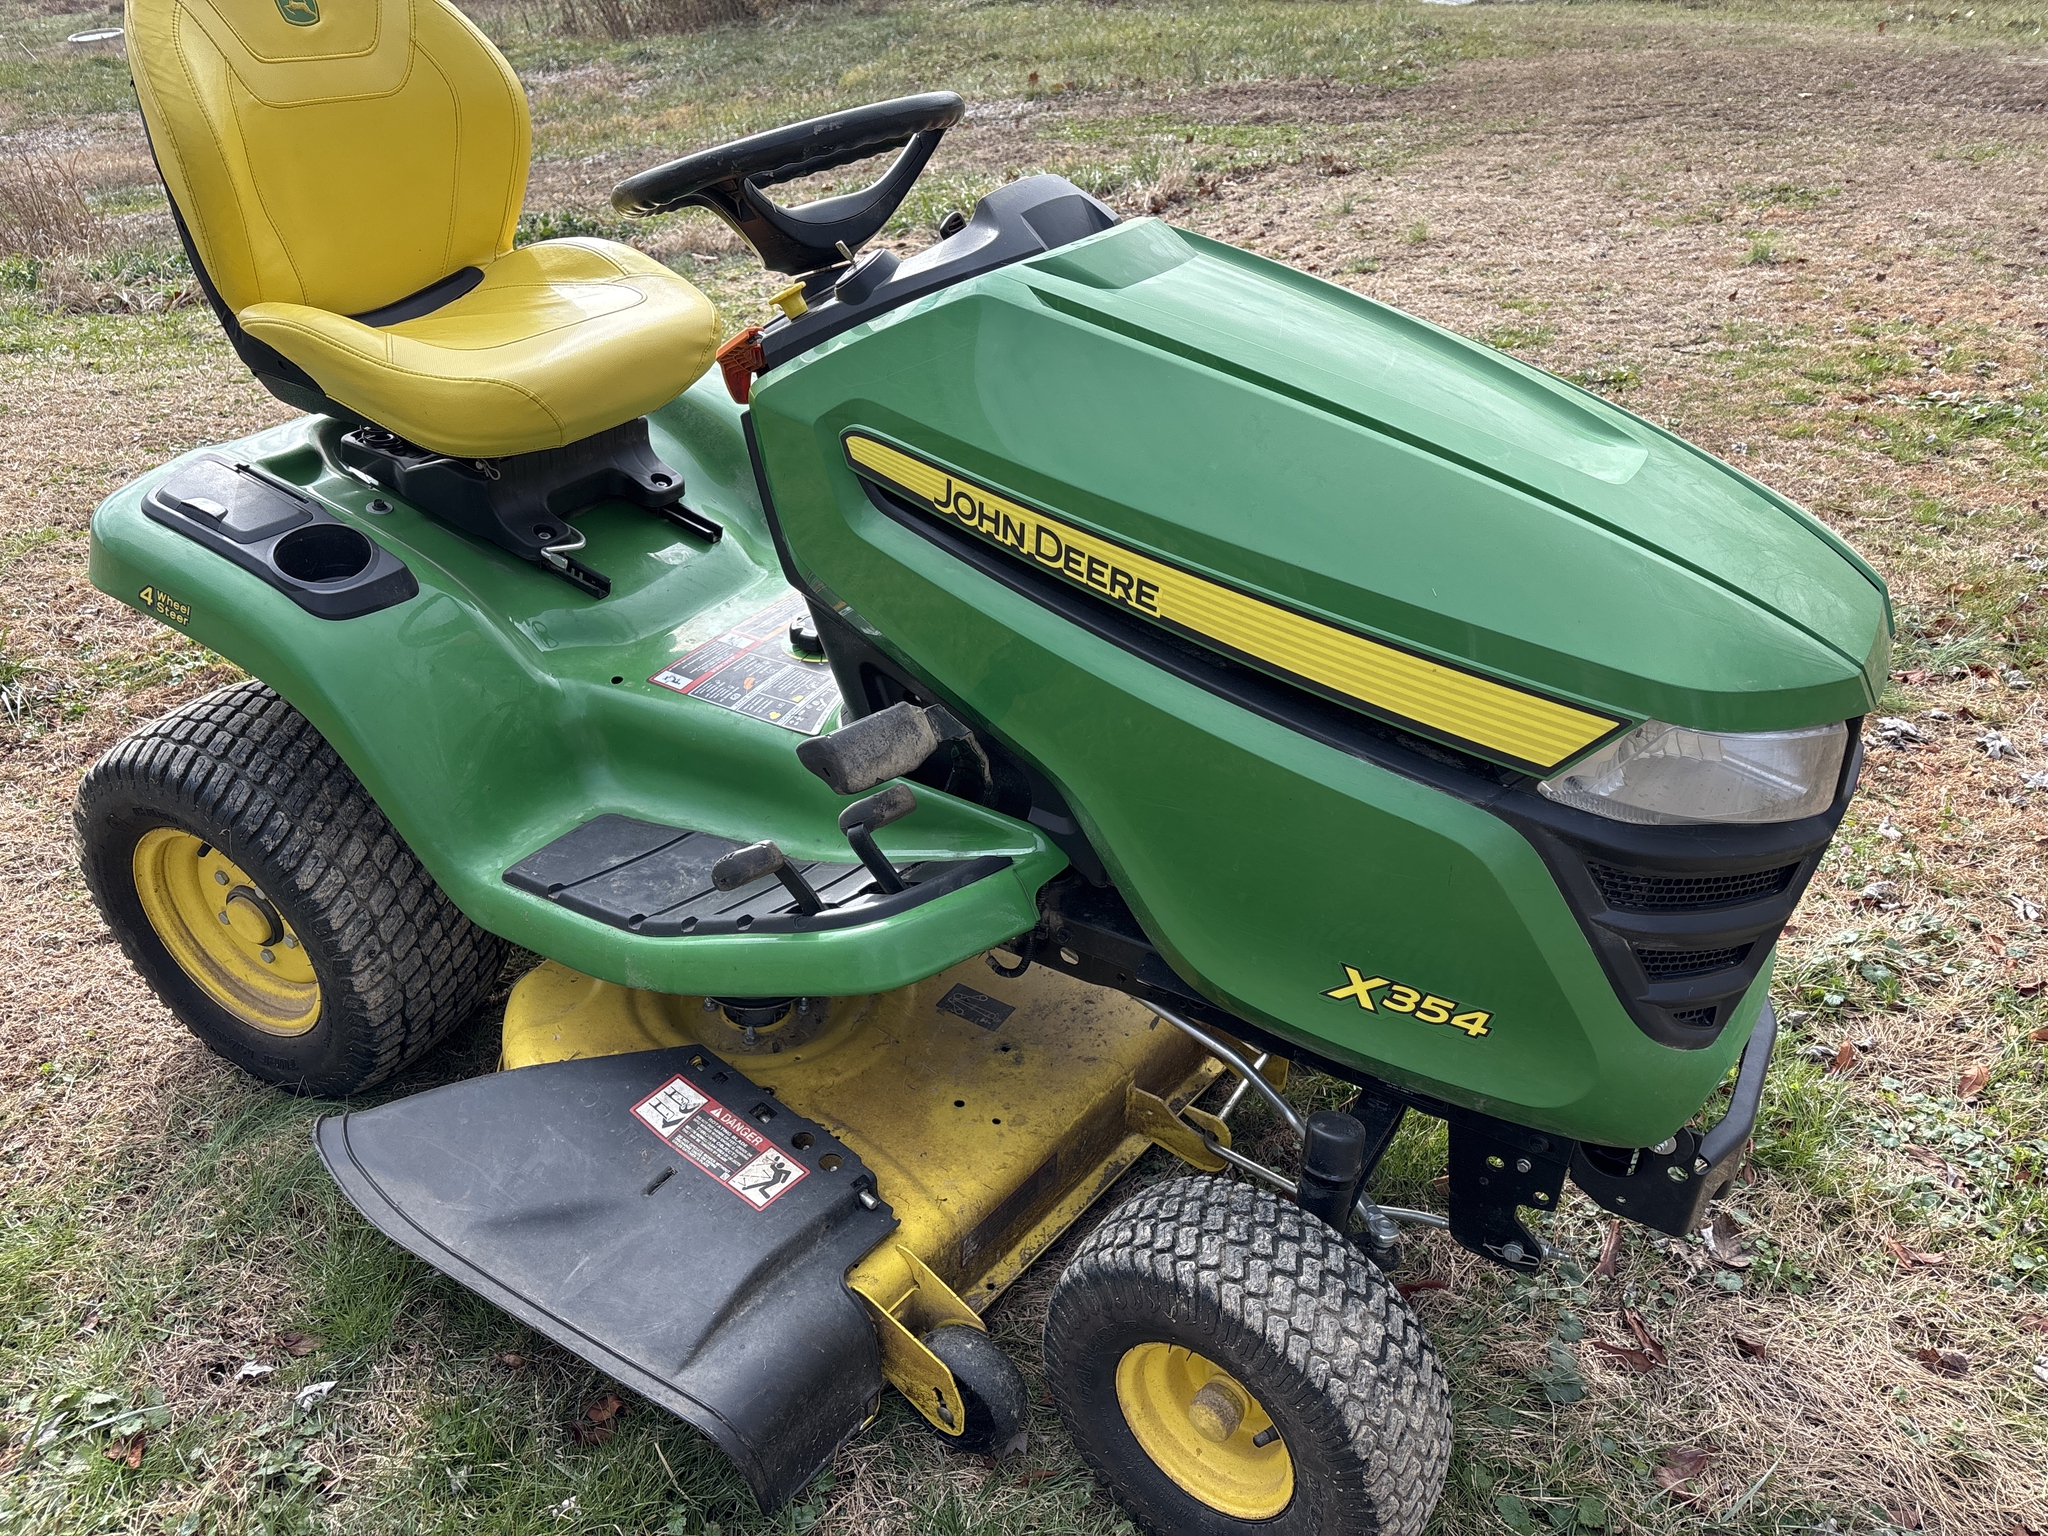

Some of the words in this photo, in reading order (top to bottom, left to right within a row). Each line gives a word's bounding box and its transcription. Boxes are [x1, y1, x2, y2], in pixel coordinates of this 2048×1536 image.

[933, 478, 1026, 549] JOHN
[1034, 523, 1160, 613] DEERE
[139, 586, 153, 606] 4
[156, 590, 191, 616] Wheel
[156, 601, 189, 626] Steer
[1325, 965, 1491, 1037] X354
[695, 1126, 716, 1143] THROWN
[715, 1140, 738, 1159] OBJECTS
[707, 1117, 731, 1136] ROTATING
[731, 1134, 748, 1148] BLADE
[720, 1113, 763, 1146] DANGER
[1077, 1319, 1142, 1404] CARLISLE
